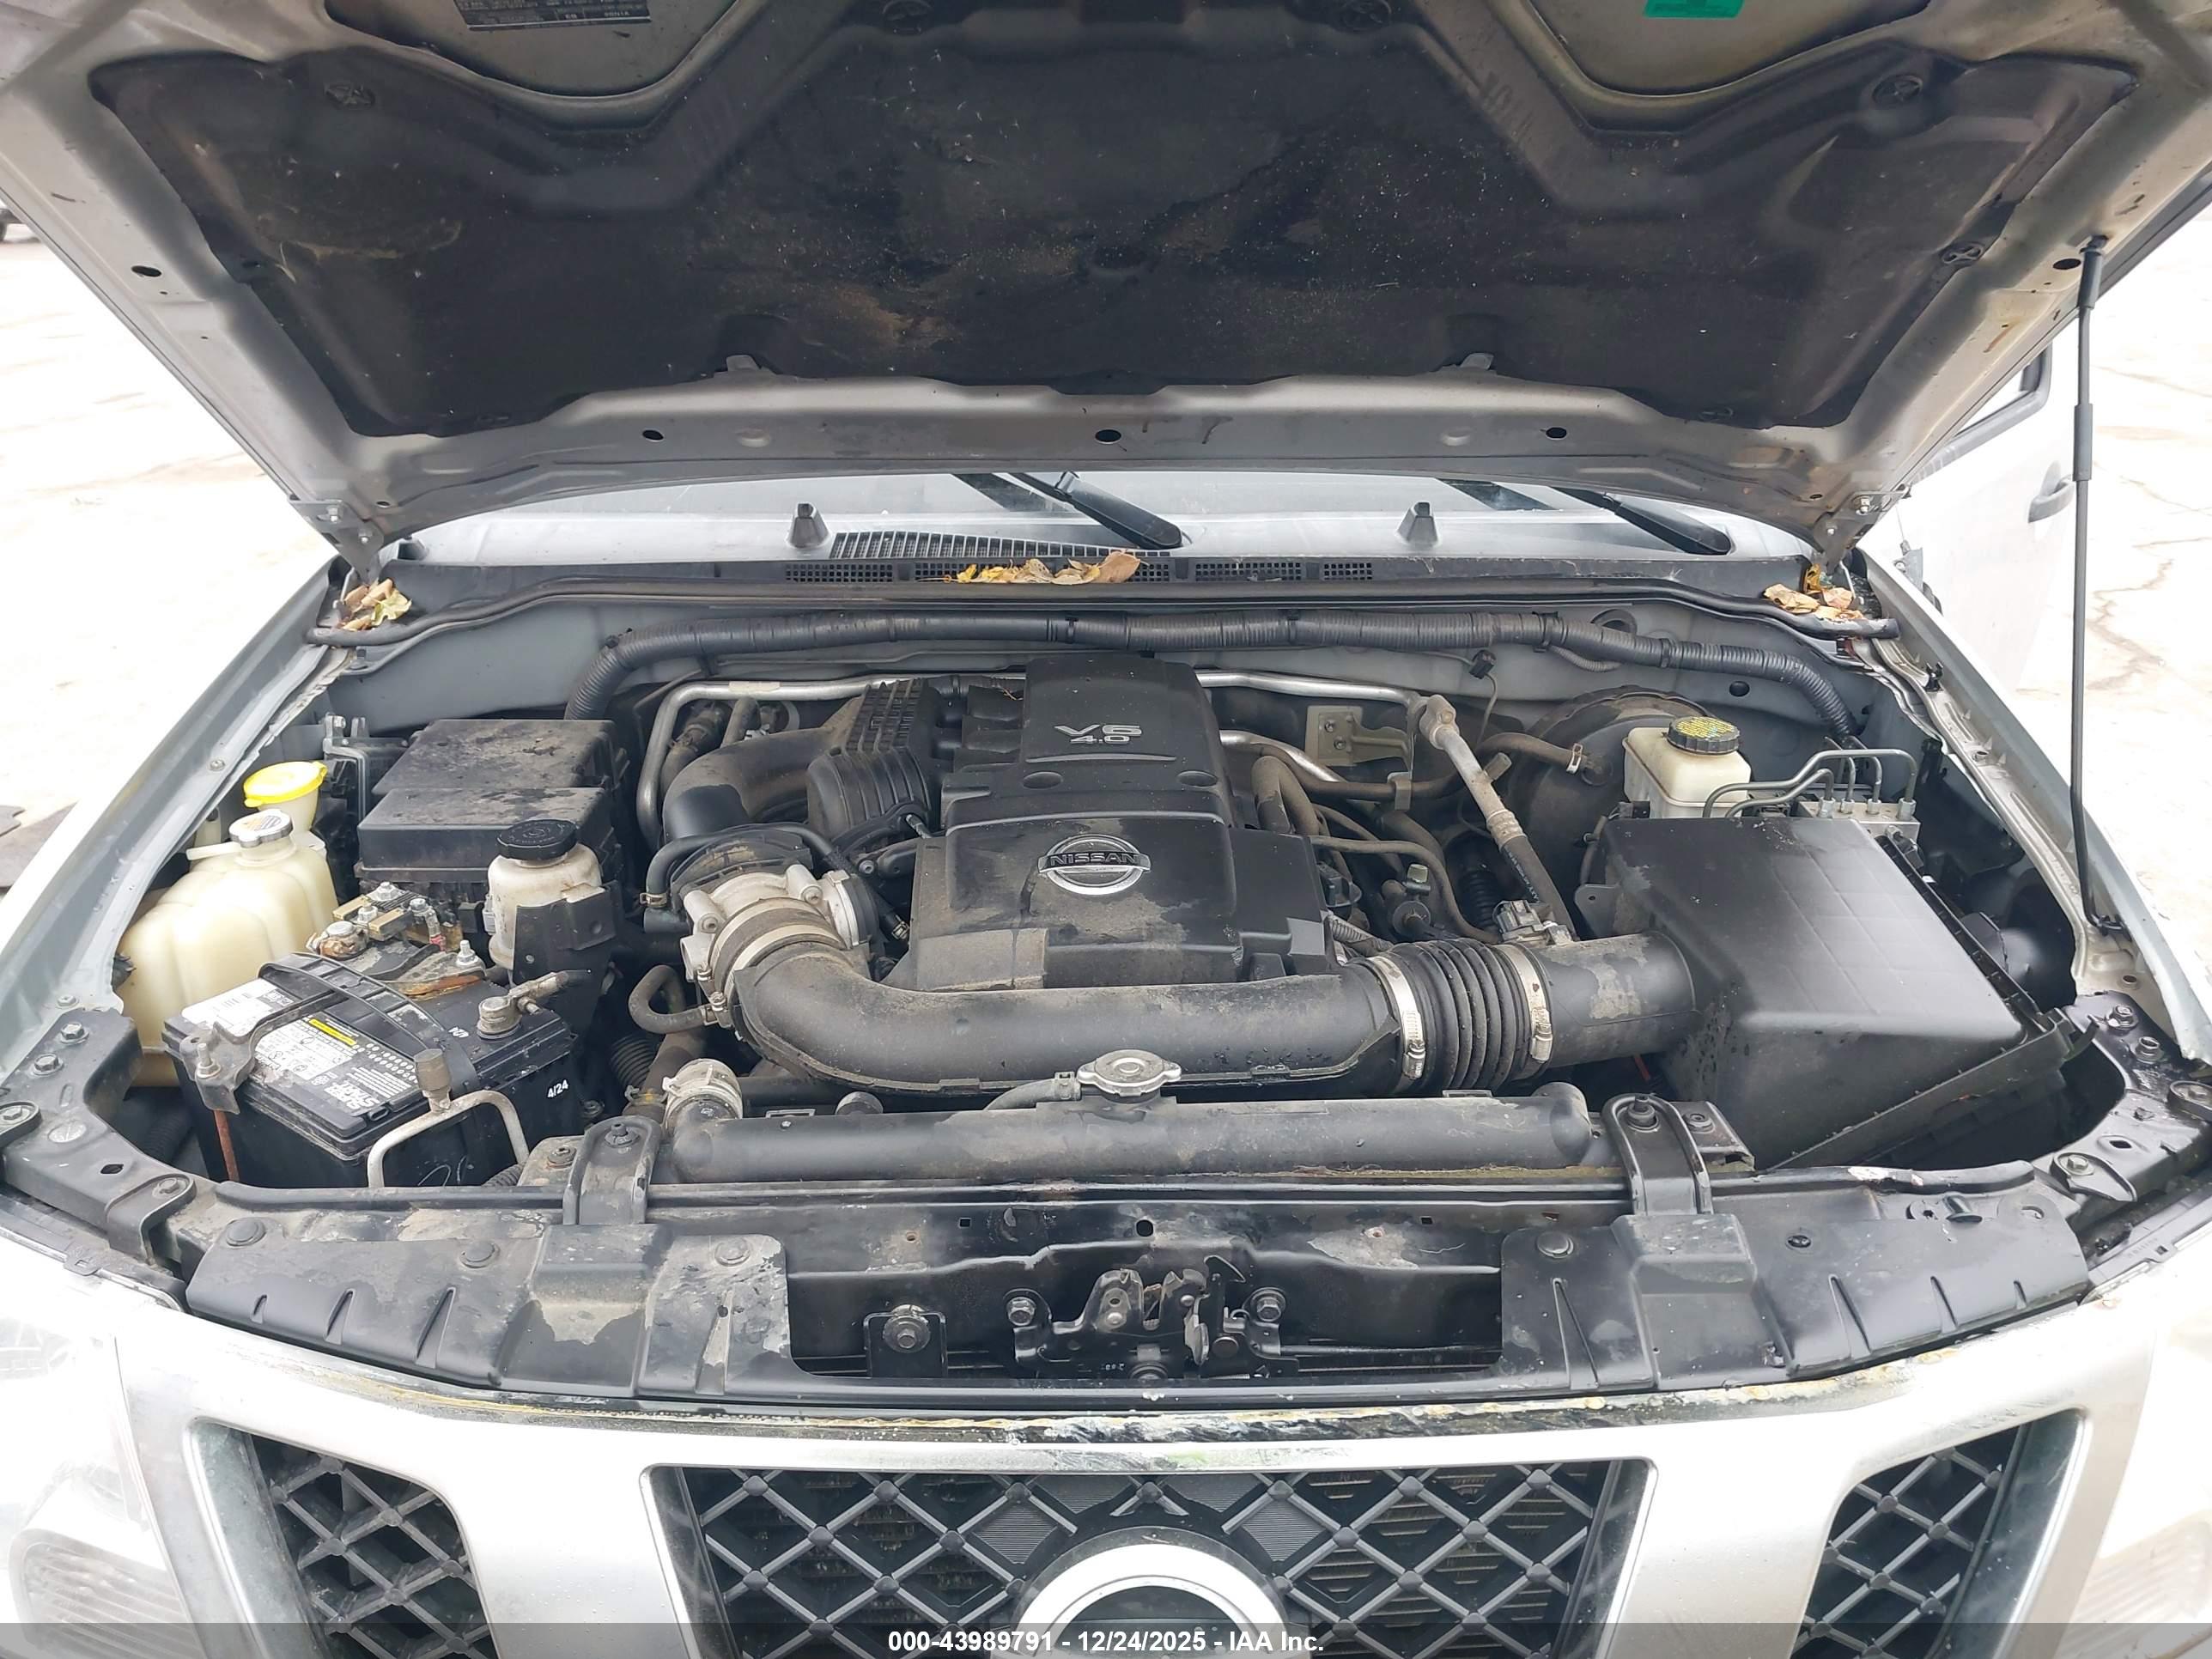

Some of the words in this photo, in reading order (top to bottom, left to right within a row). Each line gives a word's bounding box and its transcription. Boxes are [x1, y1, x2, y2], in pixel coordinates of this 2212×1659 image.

[1054, 724, 1143, 737] V6
[1070, 735, 1131, 745] 4.0
[1050, 853, 1139, 866] NISSAN
[547, 1079, 568, 1098] 4/24
